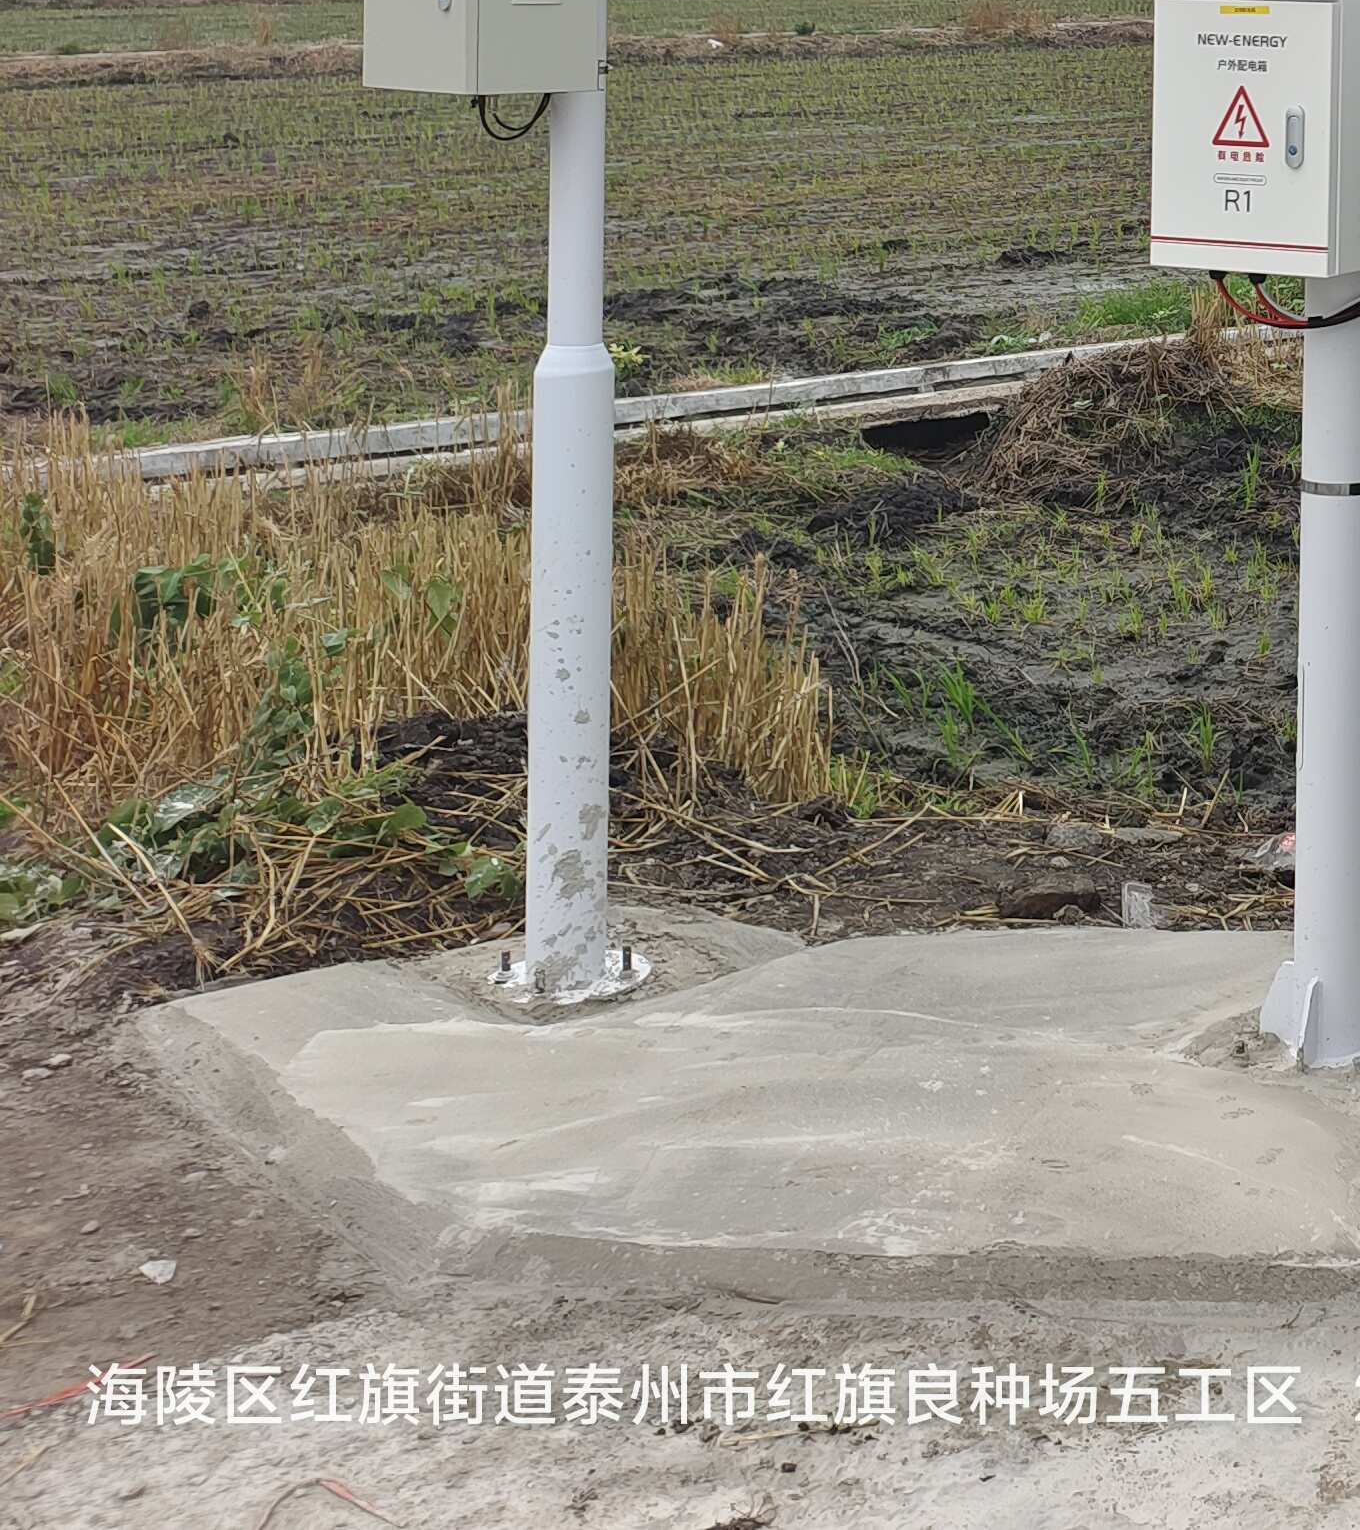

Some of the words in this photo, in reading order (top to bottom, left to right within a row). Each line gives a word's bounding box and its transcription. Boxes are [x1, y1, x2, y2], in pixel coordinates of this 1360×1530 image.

[1197, 33, 1288, 48] NEW-ENERGY
[1217, 58, 1268, 73] 户外配电箱
[1224, 189, 1251, 213] R1
